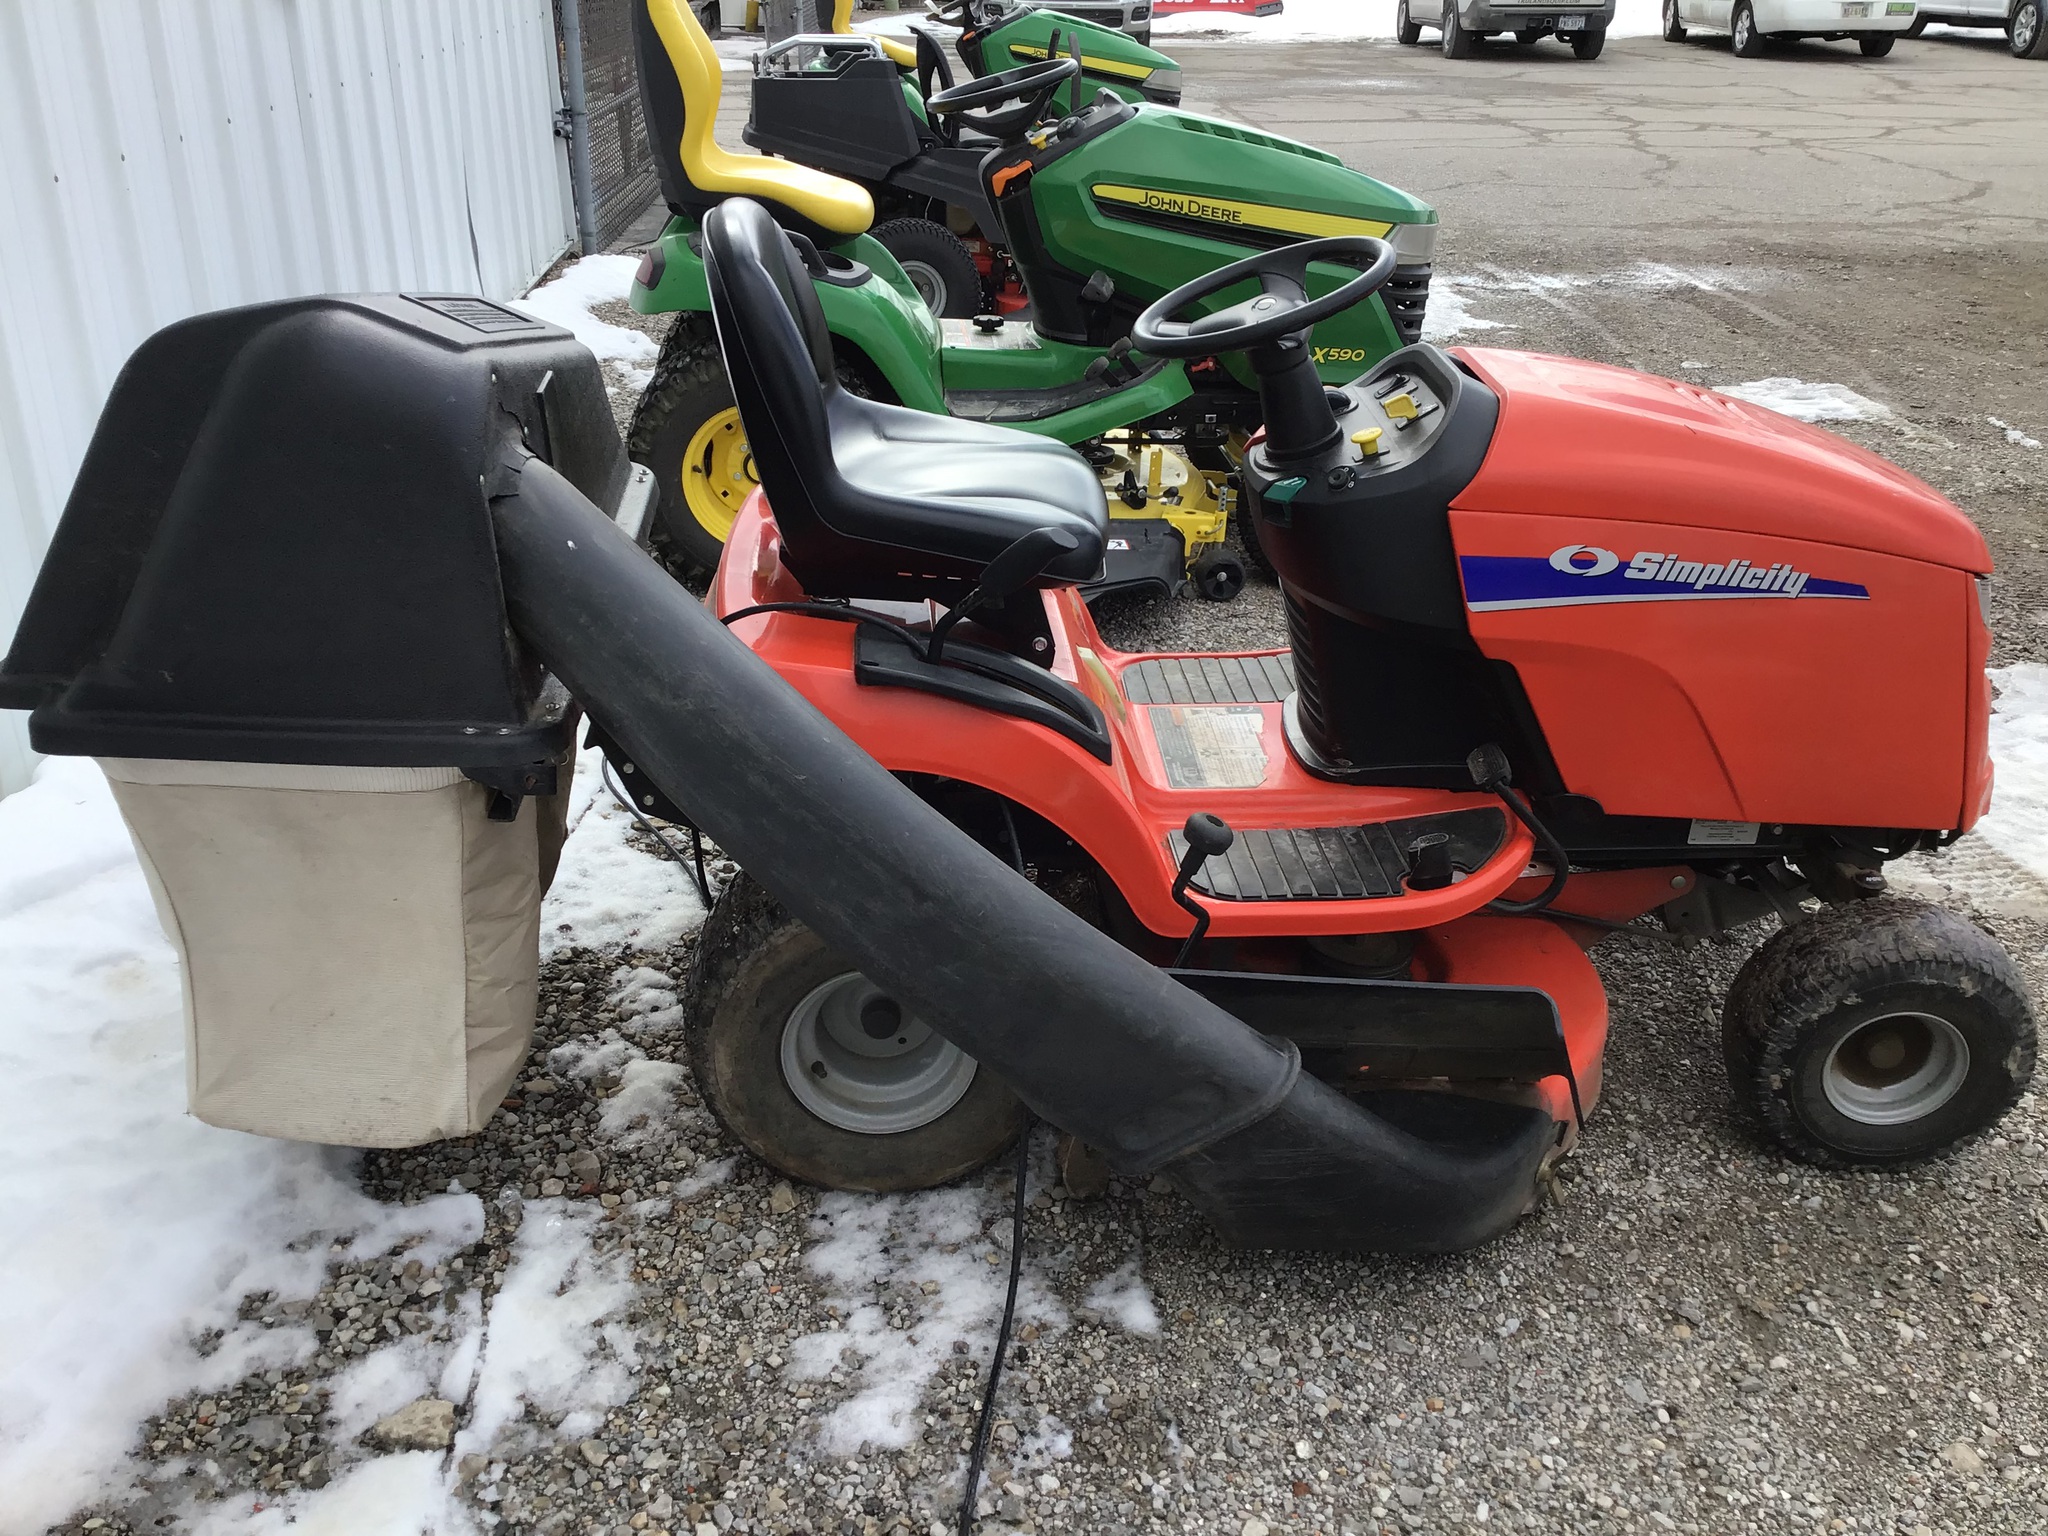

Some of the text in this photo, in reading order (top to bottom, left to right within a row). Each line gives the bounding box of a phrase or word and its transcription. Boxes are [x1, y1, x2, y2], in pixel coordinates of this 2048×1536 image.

[1138, 191, 1243, 223] JOHN DEERE
[1312, 346, 1366, 364] X590
[1624, 551, 1811, 599] Simplicity
